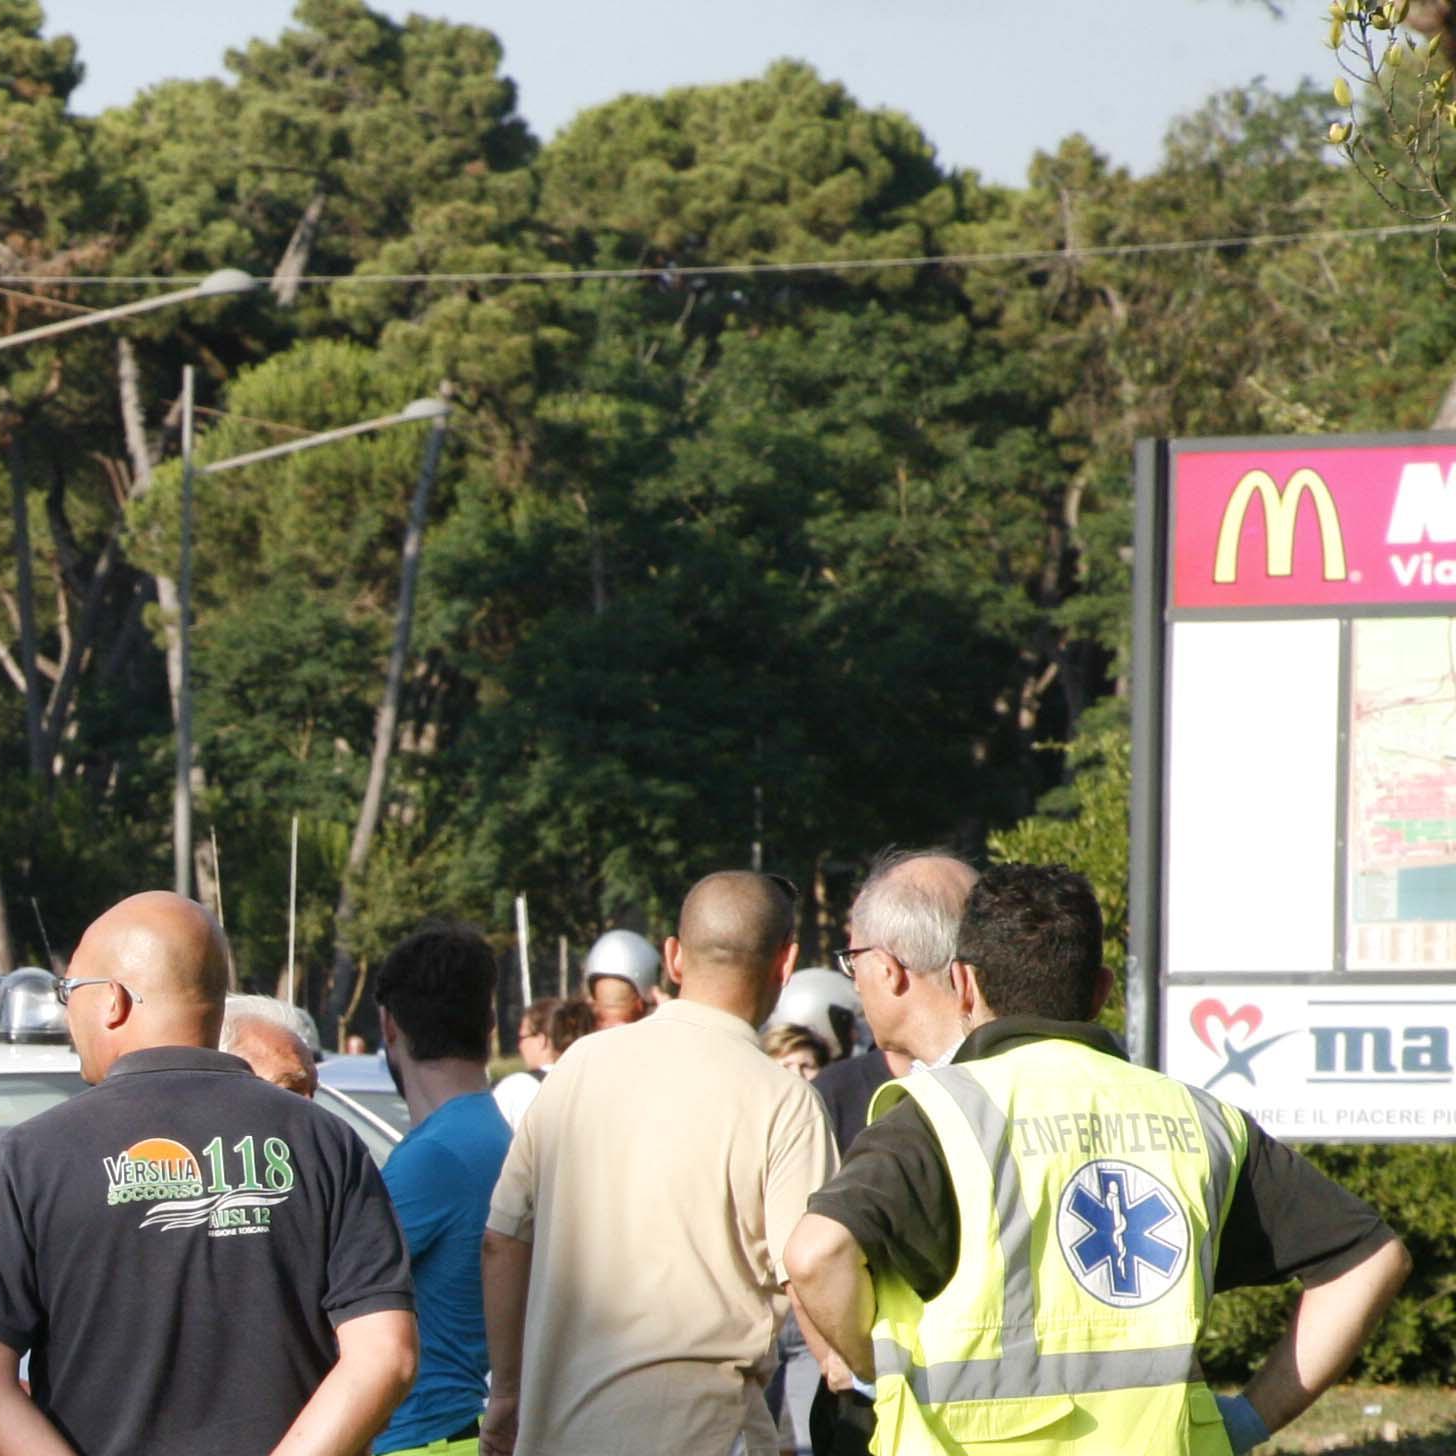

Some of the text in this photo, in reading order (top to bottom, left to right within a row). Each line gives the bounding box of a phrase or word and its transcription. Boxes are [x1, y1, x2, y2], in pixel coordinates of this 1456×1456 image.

[1336, 1108, 1425, 1125] PIACERE
[1016, 1112, 1201, 1157] INFERMIERE
[103, 1135, 295, 1193] VERSILIA 118
[107, 1183, 204, 1206] SOCCORSO
[208, 1206, 271, 1229] AUSL 12
